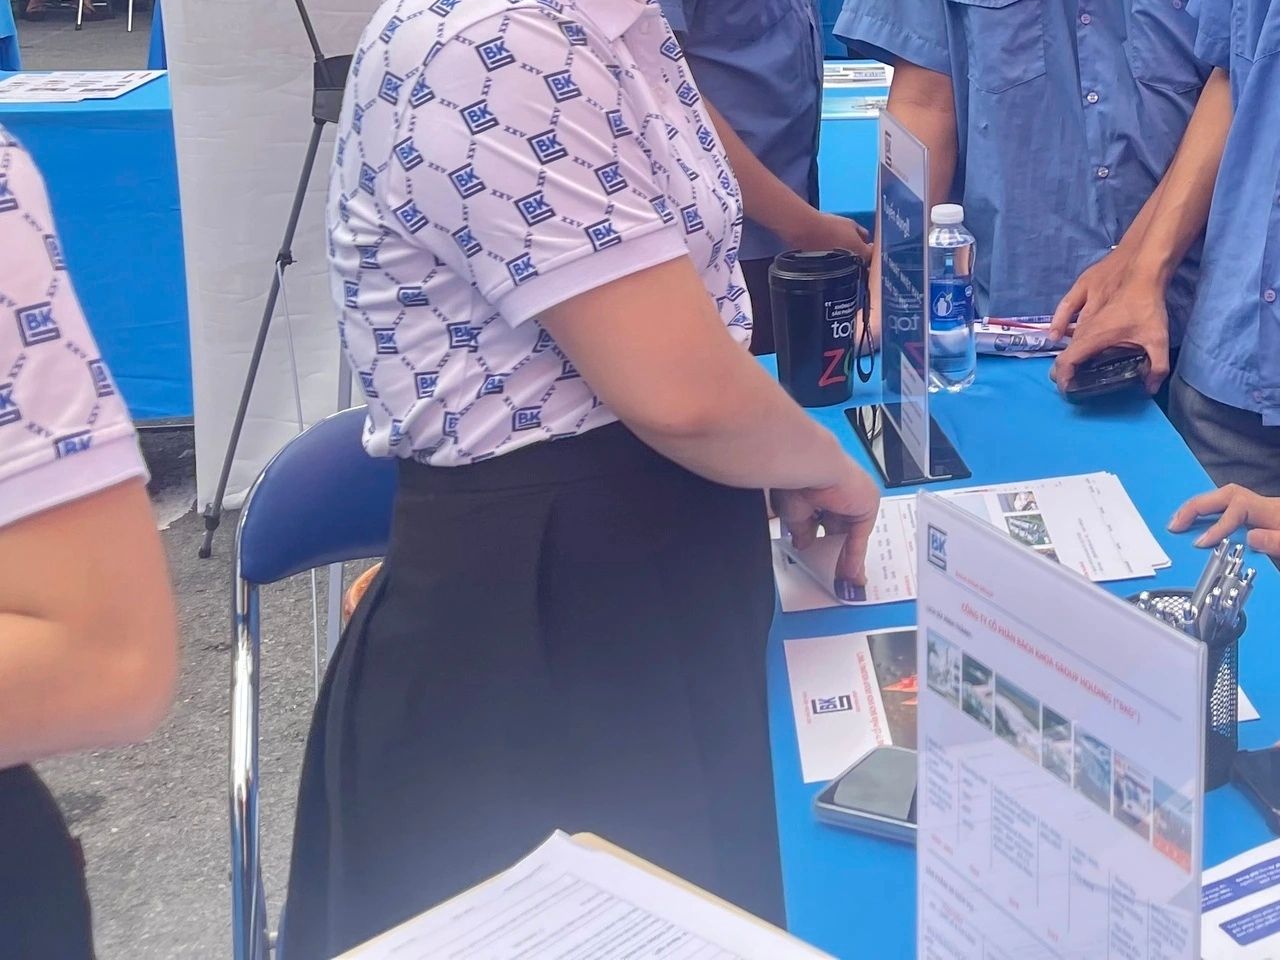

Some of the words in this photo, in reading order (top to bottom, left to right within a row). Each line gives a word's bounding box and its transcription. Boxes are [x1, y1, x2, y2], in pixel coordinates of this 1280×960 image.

[563, 23, 586, 38] BK
[483, 39, 511, 60] BK
[551, 73, 578, 92] BK
[467, 102, 494, 123] BK
[399, 141, 419, 159] BK
[537, 132, 563, 153] BK
[454, 166, 480, 187] BK
[601, 165, 623, 186] BK
[400, 202, 422, 224] BK
[523, 194, 550, 215] BK
[592, 222, 619, 242] BK
[512, 255, 536, 277] BK
[26, 308, 56, 330] BK
[376, 332, 395, 345] BK
[518, 411, 542, 426] BK
